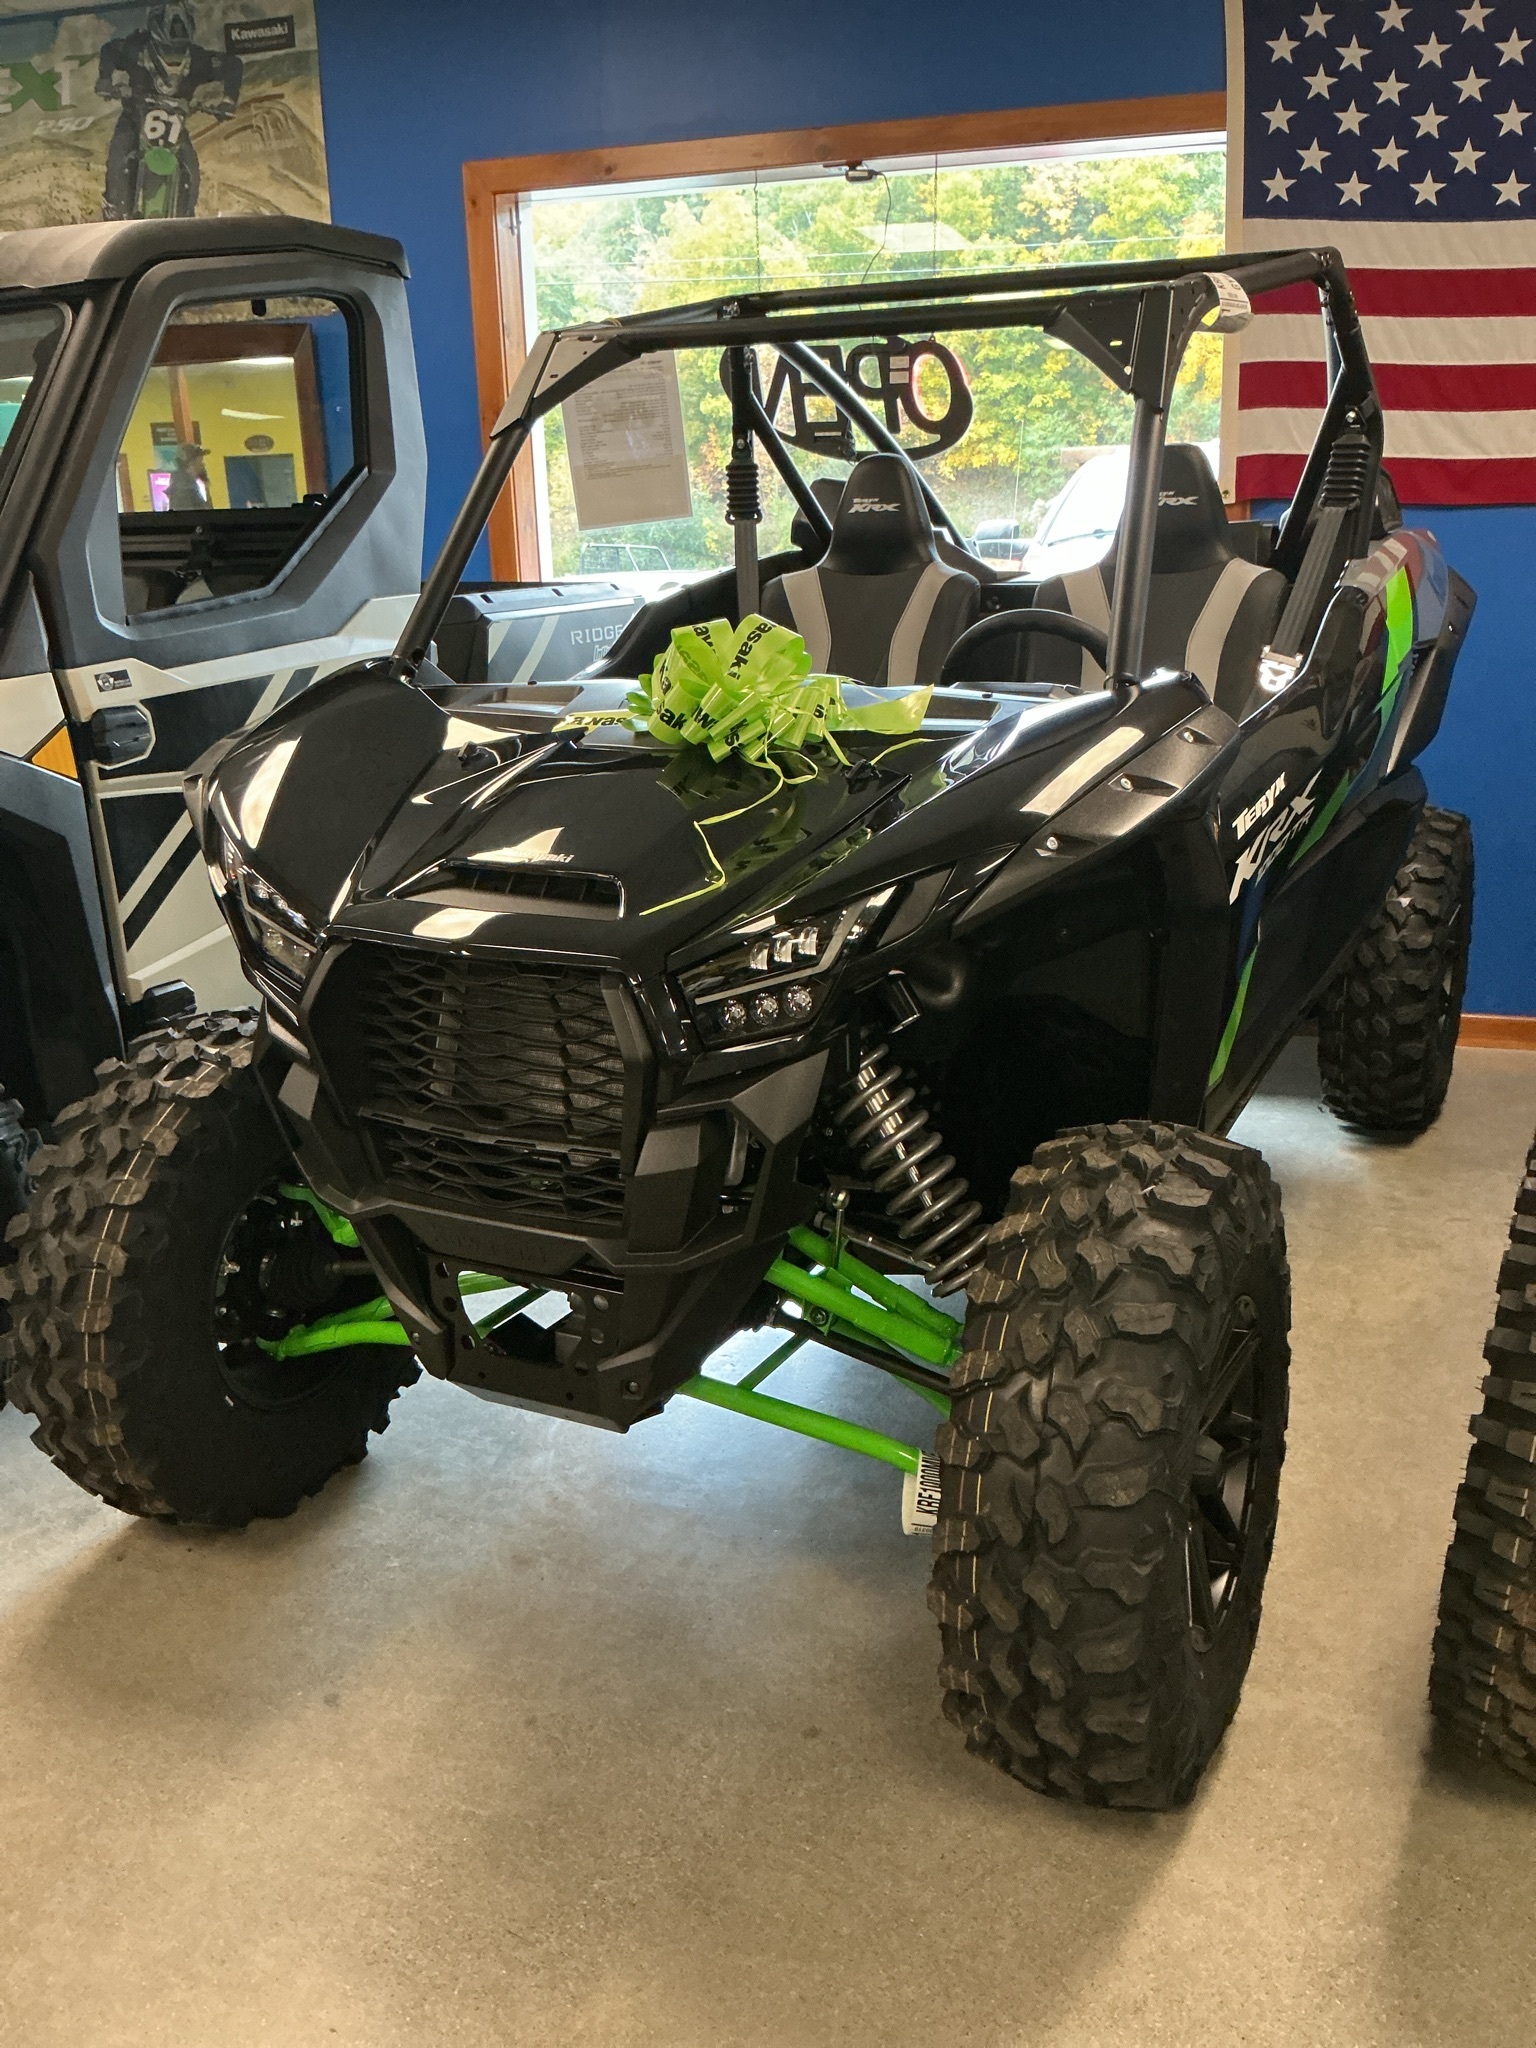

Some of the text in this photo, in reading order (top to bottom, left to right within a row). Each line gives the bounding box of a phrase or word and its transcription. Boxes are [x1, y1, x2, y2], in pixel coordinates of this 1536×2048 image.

[230, 21, 289, 41] Kawasaki
[33, 116, 95, 135] 250
[143, 108, 182, 145] 61
[848, 503, 901, 514] KRX
[1158, 496, 1199, 507] RX
[1229, 767, 1324, 906] KRX
